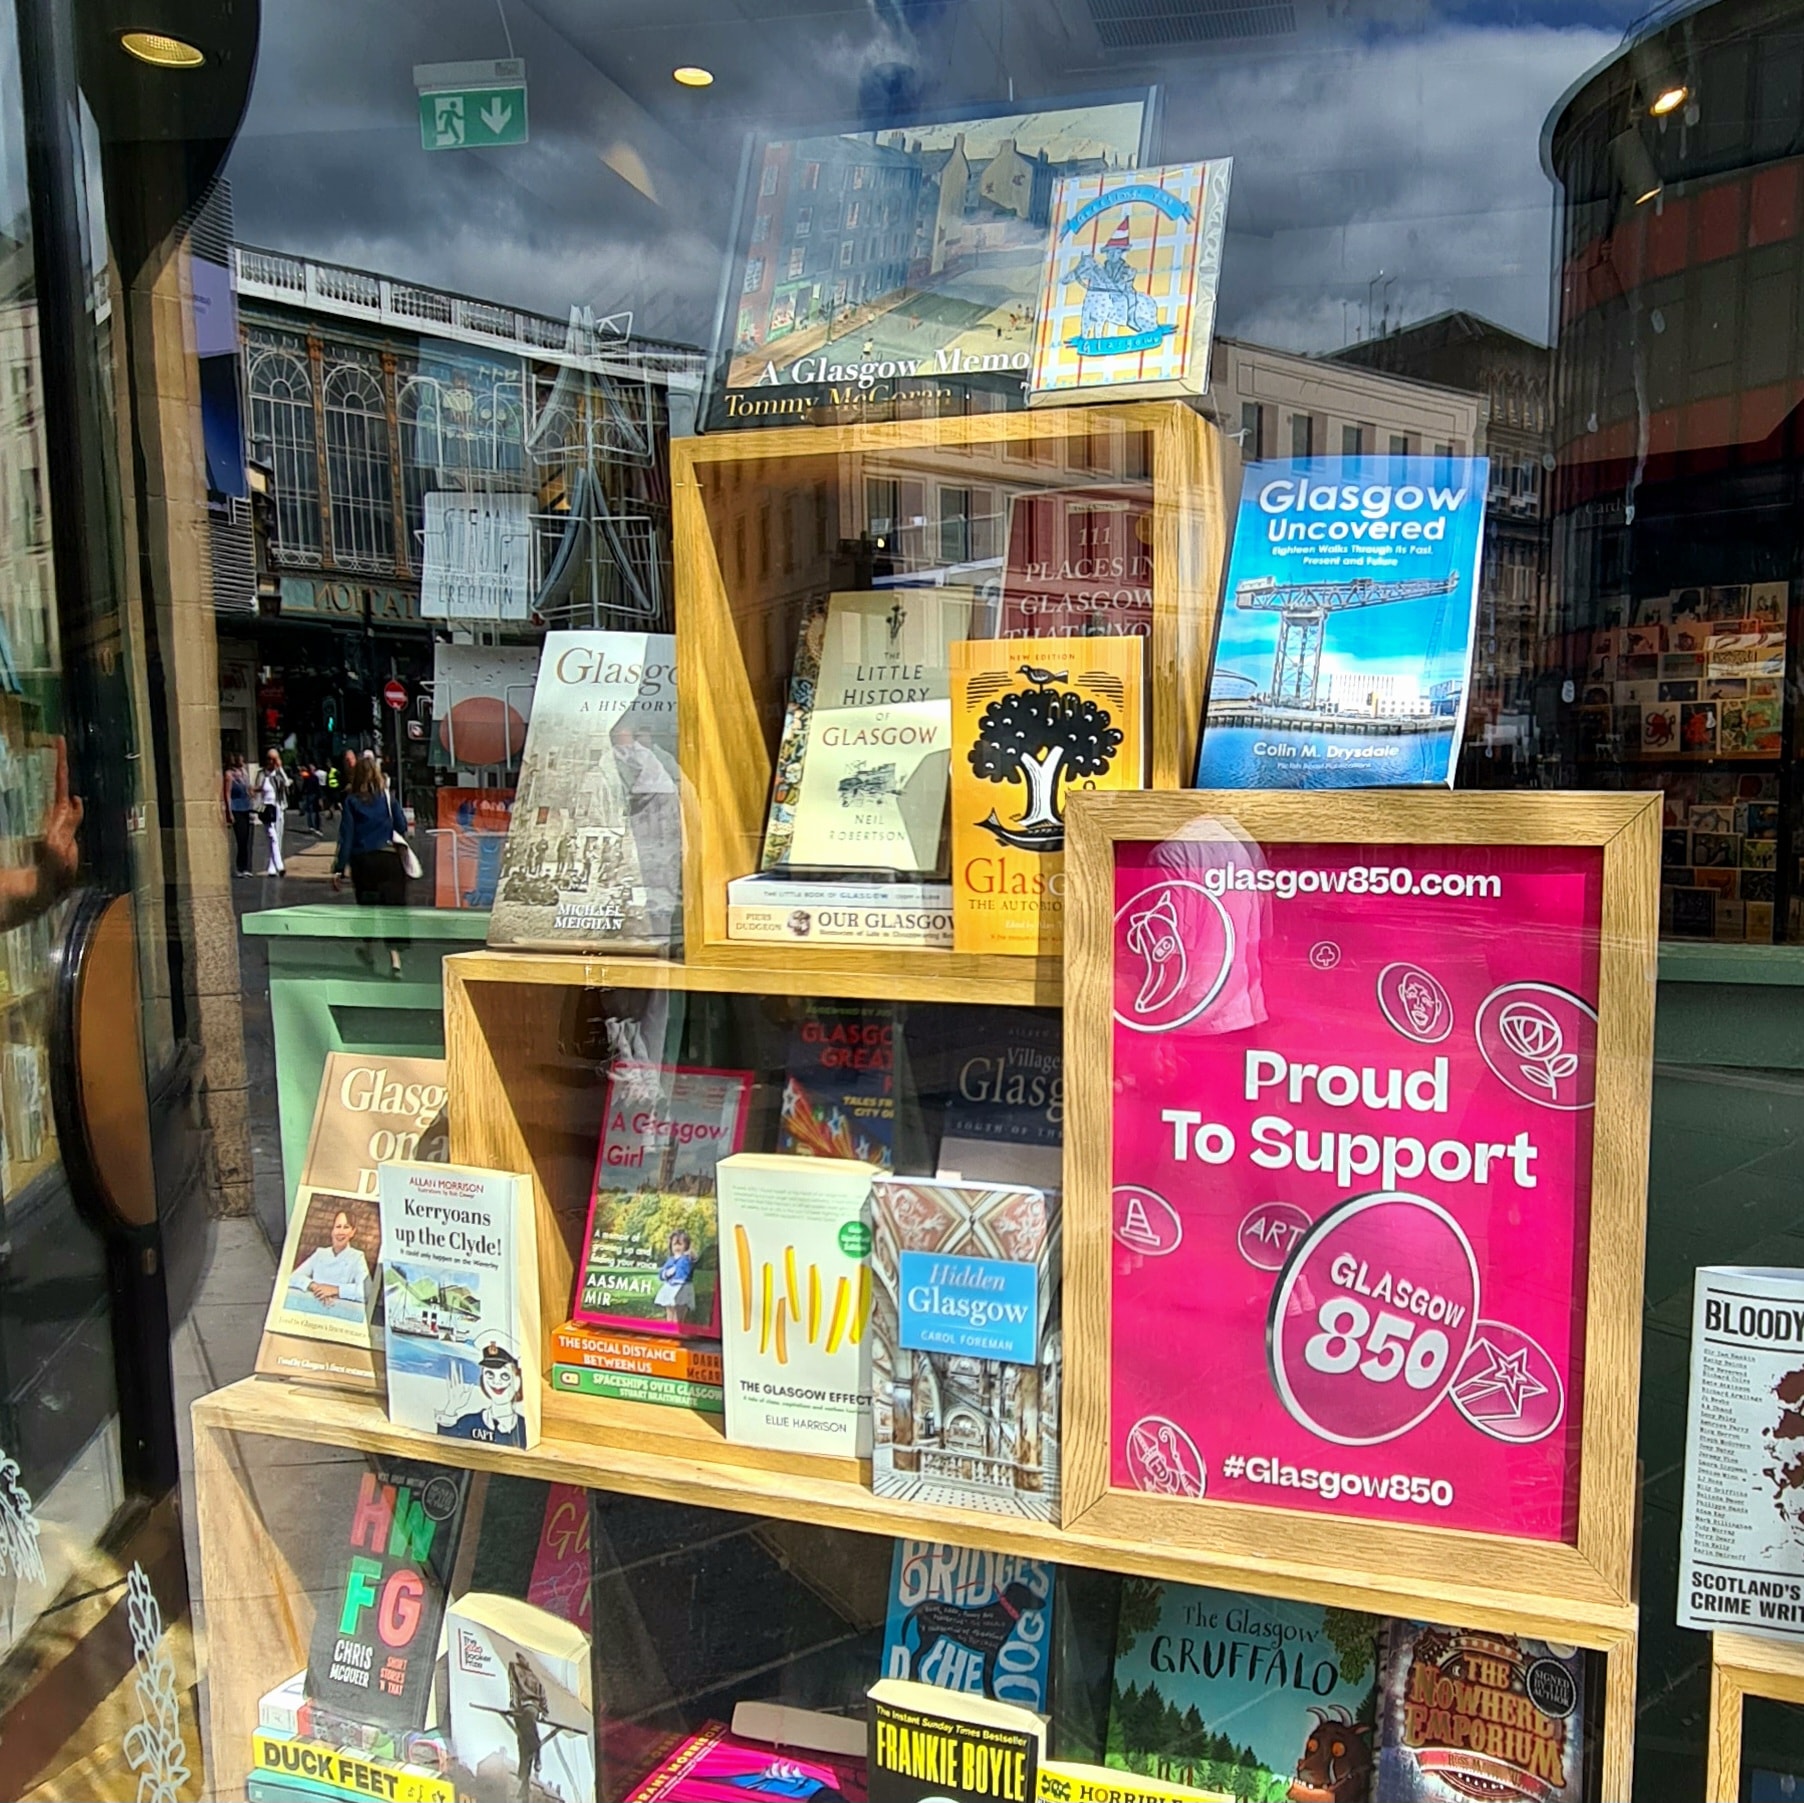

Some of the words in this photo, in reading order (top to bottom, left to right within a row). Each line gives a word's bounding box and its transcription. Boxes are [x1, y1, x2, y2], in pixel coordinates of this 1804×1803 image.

[757, 360, 779, 385] A
[791, 355, 922, 388] Glasgow
[932, 347, 1031, 373] Memo
[724, 393, 819, 421] Tommy
[1258, 479, 1467, 519] Glasgow
[1078, 526, 1112, 546] 111
[1267, 516, 1446, 542] Uncovered
[1272, 545, 1315, 556] Eighteen
[1318, 544, 1348, 554] Walks
[1351, 544, 1393, 556] Through
[1303, 556, 1341, 565] Present
[1343, 556, 1364, 566] and
[1366, 556, 1399, 566] Future
[1025, 556, 1124, 582] PLACES
[1020, 588, 1153, 615] GLASGOW
[1114, 622, 1152, 638] YO
[884, 651, 900, 660] THE
[1035, 652, 1076, 661] EDITION
[555, 646, 678, 696] Glasg
[856, 664, 923, 681] LITTLE
[579, 700, 590, 712] A
[599, 700, 678, 713] HISTORY
[843, 687, 930, 705] HISTORY
[875, 712, 890, 721] OF
[822, 726, 937, 746] GLASGOW
[1253, 741, 1296, 757] Colin
[1300, 744, 1321, 757] M.
[1326, 744, 1399, 760] Drysdale
[854, 813, 884, 825] NEIL
[829, 830, 905, 842] ROBERTSON
[1204, 862, 1502, 899] glasgow850.com
[968, 899, 995, 911] THE
[1001, 899, 1062, 912] AUTOBIO
[818, 911, 859, 928] OUR
[802, 1022, 893, 1046] GLASGO
[1007, 1046, 1062, 1075] Village
[959, 1056, 1063, 1122] Glasg
[1244, 1048, 1449, 1113] Proud
[340, 1065, 449, 1128] Glasg
[611, 1111, 625, 1132] A
[854, 1107, 880, 1118] CITY
[956, 1121, 1003, 1134] SOUTH
[1011, 1125, 1028, 1136] OF
[369, 1129, 417, 1164] on
[605, 1143, 644, 1168] Girl
[1161, 1109, 1235, 1165] To
[1249, 1115, 1538, 1192] Support
[409, 1177, 436, 1188] ALLAN
[438, 1180, 484, 1193] MORRISON
[404, 1198, 491, 1226] Kerryoans
[395, 1227, 415, 1247] up
[418, 1226, 446, 1248] the
[449, 1231, 502, 1257] Clyde!
[631, 1232, 641, 1242] of
[1245, 1214, 1303, 1252] ART
[615, 1259, 635, 1268] your
[636, 1259, 657, 1269] voice
[624, 1247, 634, 1256] up
[635, 1246, 652, 1256] and
[586, 1273, 652, 1295] AASMAH
[928, 1263, 1006, 1291] Hidden
[584, 1290, 611, 1306] MIR
[1329, 1252, 1466, 1329] GLASGOW
[906, 1285, 1028, 1327] Glasgow
[558, 1335, 581, 1349] THE
[581, 1338, 621, 1355] SOCIAL
[622, 1344, 677, 1362] DISTANCE
[920, 1328, 955, 1345] CAROL
[959, 1332, 1013, 1351] FOREMAN
[1304, 1301, 1450, 1390] 850
[583, 1354, 636, 1371] BETWEEN
[637, 1361, 652, 1373] US
[693, 1352, 721, 1367] DARR
[593, 1373, 649, 1391] SPACESHIPS
[649, 1380, 675, 1394] OVER
[676, 1383, 723, 1400] GLASGOW
[686, 1367, 722, 1381] McGAR
[739, 1380, 760, 1393] THE
[763, 1384, 826, 1401] GLASGOW
[829, 1392, 873, 1406] EFFECT
[765, 1414, 789, 1427] ELLIE
[793, 1418, 847, 1432] HARRISON
[1222, 1454, 1454, 1506] #Glasgow850
[1691, 1570, 1801, 1602] SCOTLAND'S
[338, 1554, 424, 1648] FG
[1691, 1591, 1751, 1616] CRIME
[1758, 1596, 1804, 1623] WRIT
[1183, 1601, 1220, 1630] The
[1225, 1607, 1320, 1648] Glasgow
[334, 1639, 374, 1669] CHRIS
[1149, 1633, 1339, 1697] GRUFFALO
[329, 1663, 370, 1688] MCQUEER
[1463, 1651, 1511, 1690] THE
[1534, 1669, 1570, 1689] SIGNED
[1410, 1660, 1555, 1739] NOWHERE
[1533, 1688, 1570, 1708] AUTHOR
[1534, 1679, 1546, 1690] BY
[1551, 1683, 1569, 1697] THE
[876, 1705, 891, 1718] The
[892, 1710, 920, 1725] Instant
[922, 1717, 954, 1734] Sunday
[955, 1725, 981, 1738] Times
[983, 1730, 1027, 1747] Bestseller
[667, 1723, 723, 1773] MORRISON
[1403, 1701, 1566, 1787] EMPORIUM
[263, 1741, 335, 1781] DUCK
[338, 1759, 399, 1798] FEET
[876, 1719, 958, 1788] FRANKIE
[962, 1741, 1026, 1802] BOYLE
[1080, 1784, 1183, 1803] HORRIB
